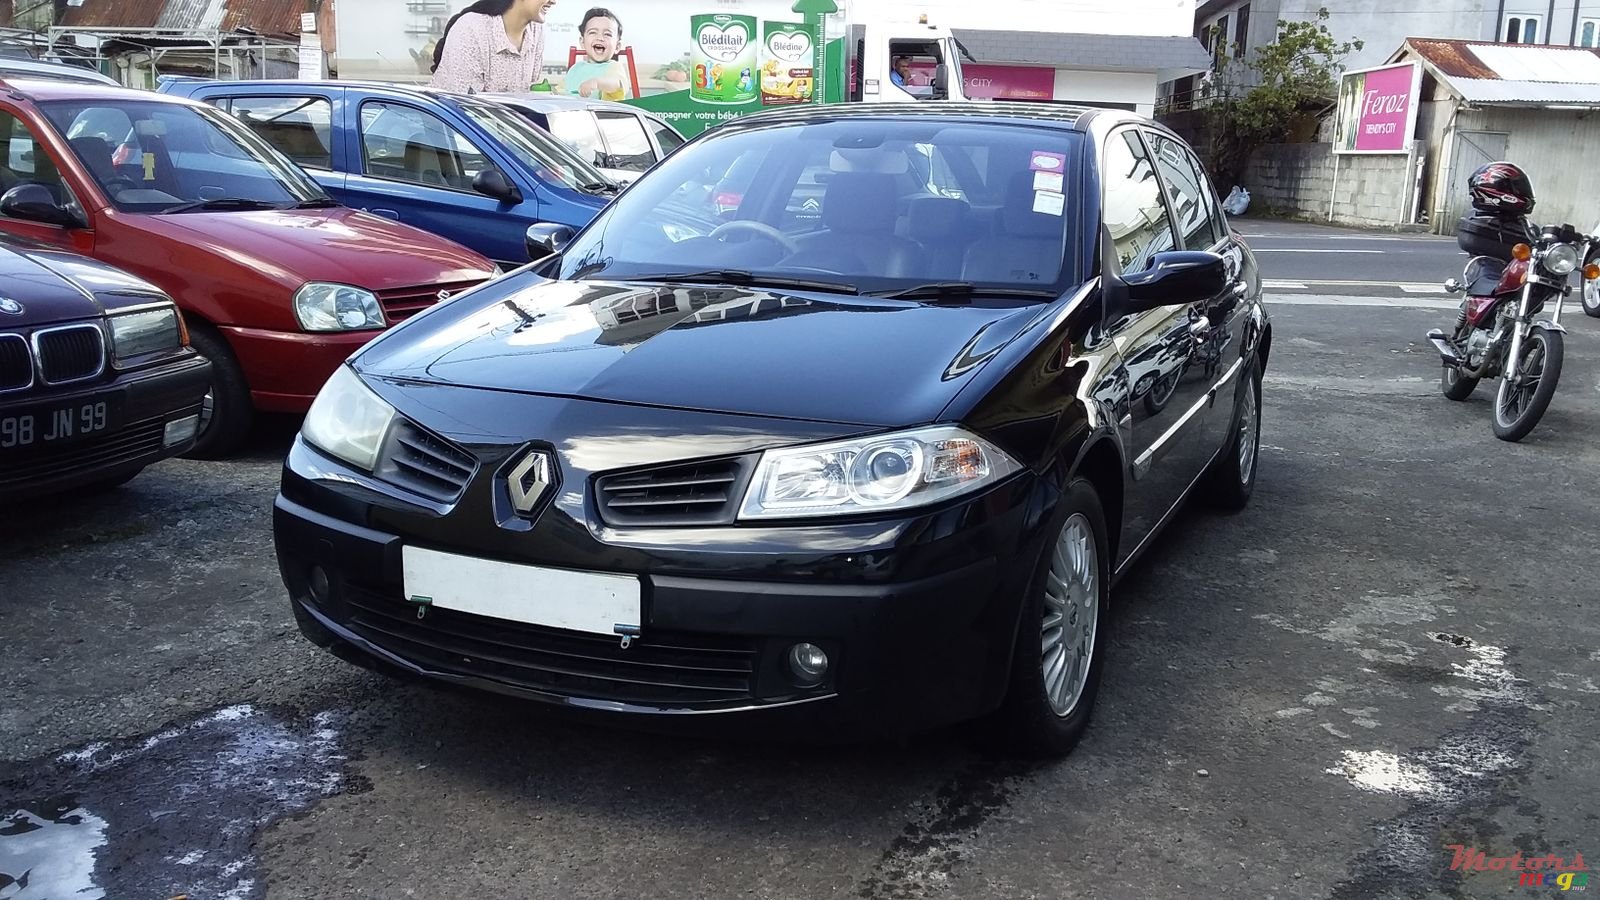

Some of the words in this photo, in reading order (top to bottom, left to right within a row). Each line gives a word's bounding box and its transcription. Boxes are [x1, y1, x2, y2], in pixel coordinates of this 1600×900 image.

[702, 34, 743, 46] Blédilait
[773, 41, 803, 51] Blédine
[970, 78, 993, 87] CITY
[1362, 89, 1408, 119] Feroz
[695, 112, 717, 120] votre
[717, 109, 739, 120] bébé
[1, 415, 34, 448] 98
[43, 408, 73, 441] JN
[80, 401, 106, 434] 99
